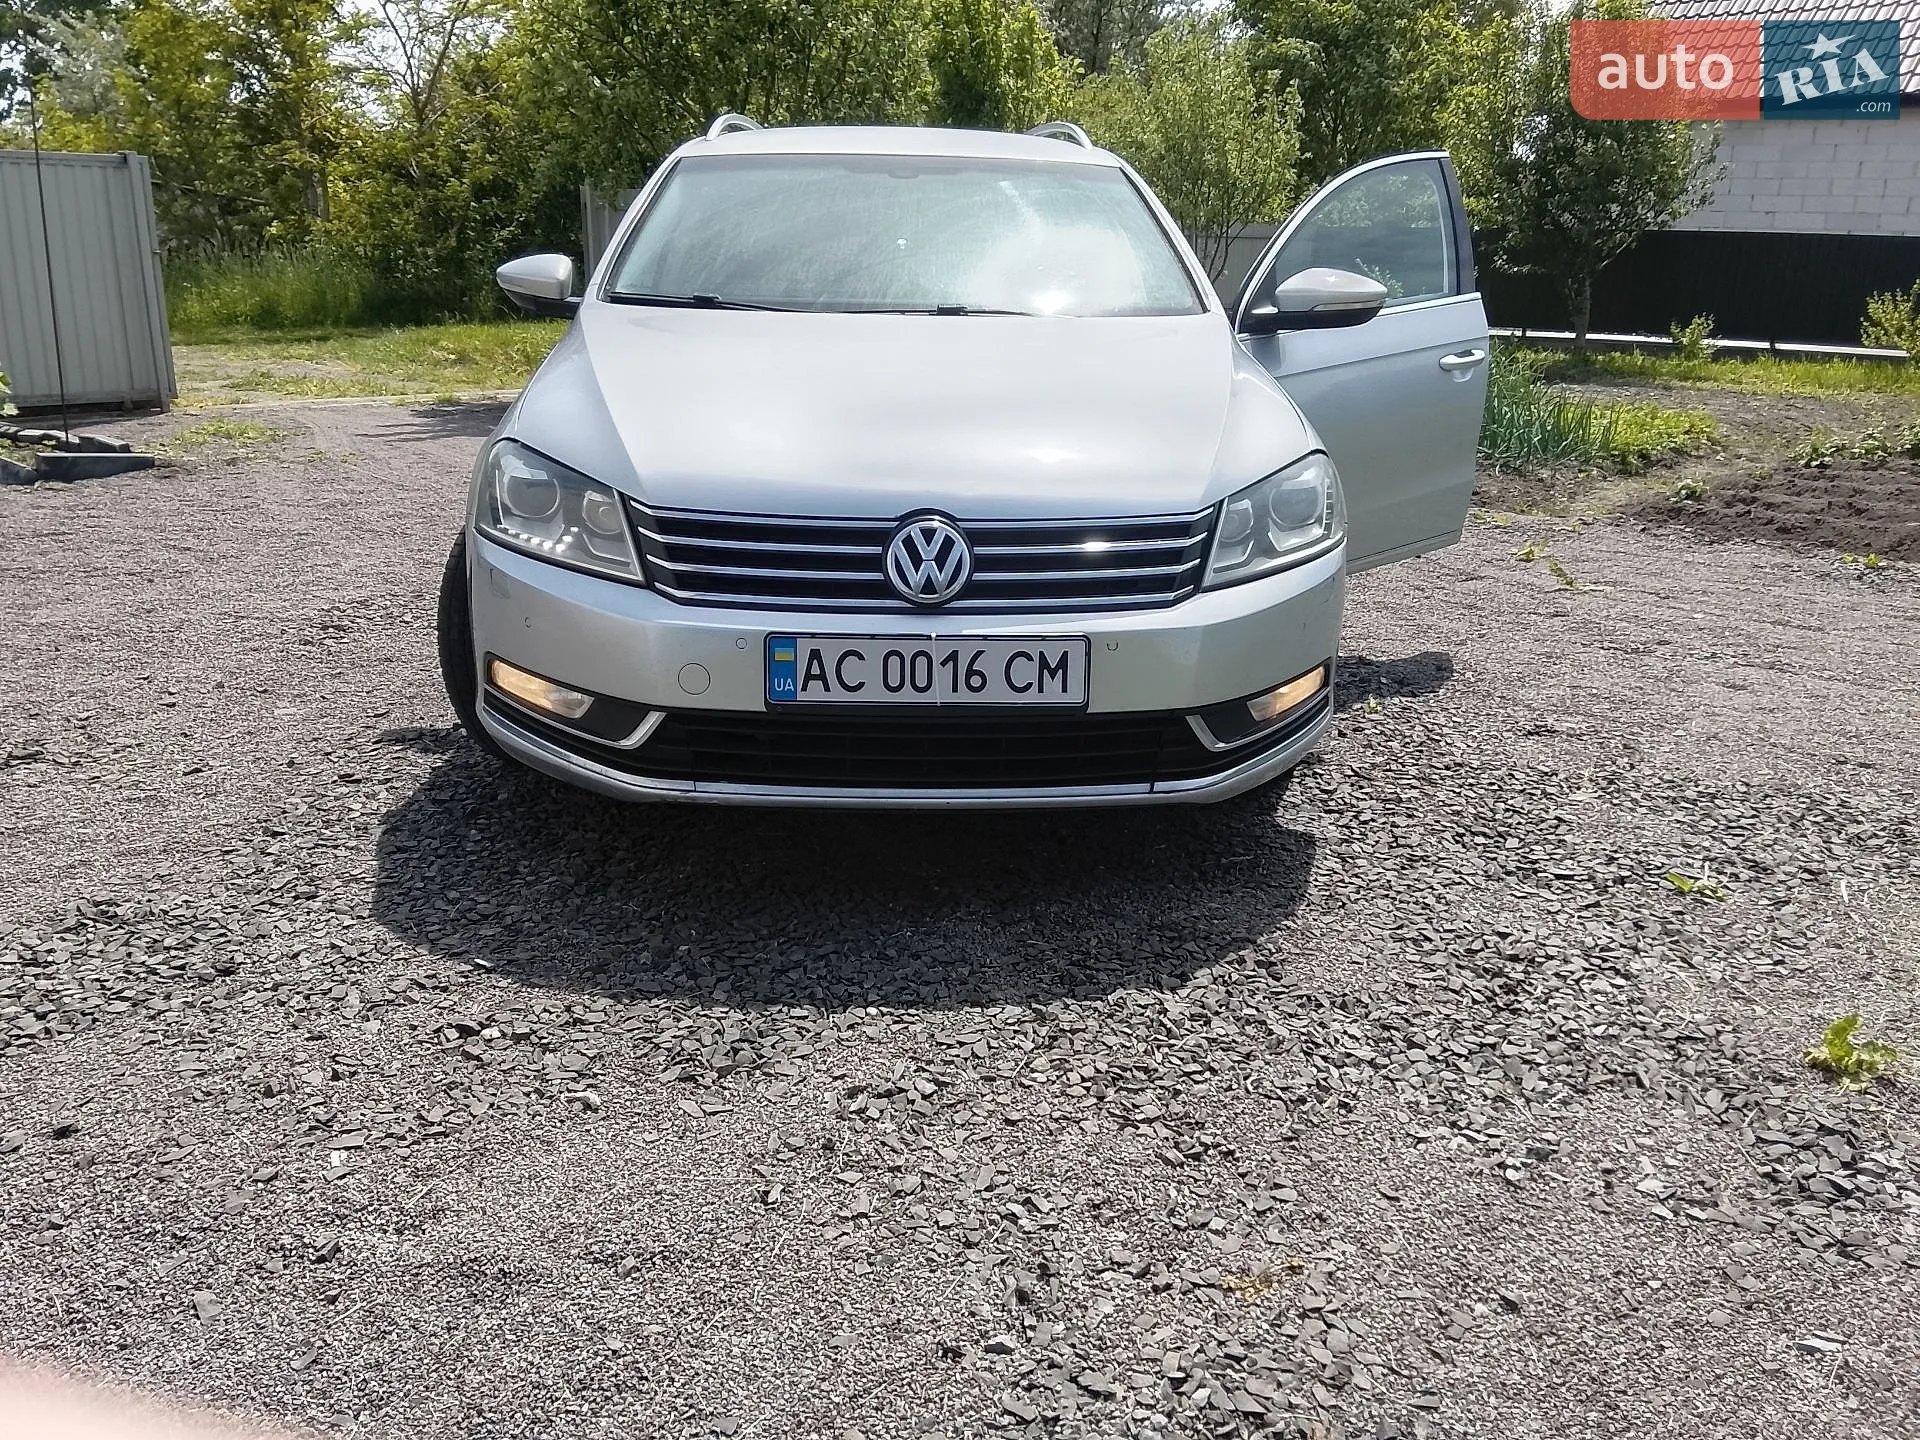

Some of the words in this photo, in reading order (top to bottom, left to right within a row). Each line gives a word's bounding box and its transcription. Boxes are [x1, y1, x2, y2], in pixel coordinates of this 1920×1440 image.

[774, 678, 795, 692] UA
[800, 648, 866, 693] AC
[882, 649, 988, 694] 0016
[1004, 650, 1069, 694] CM
